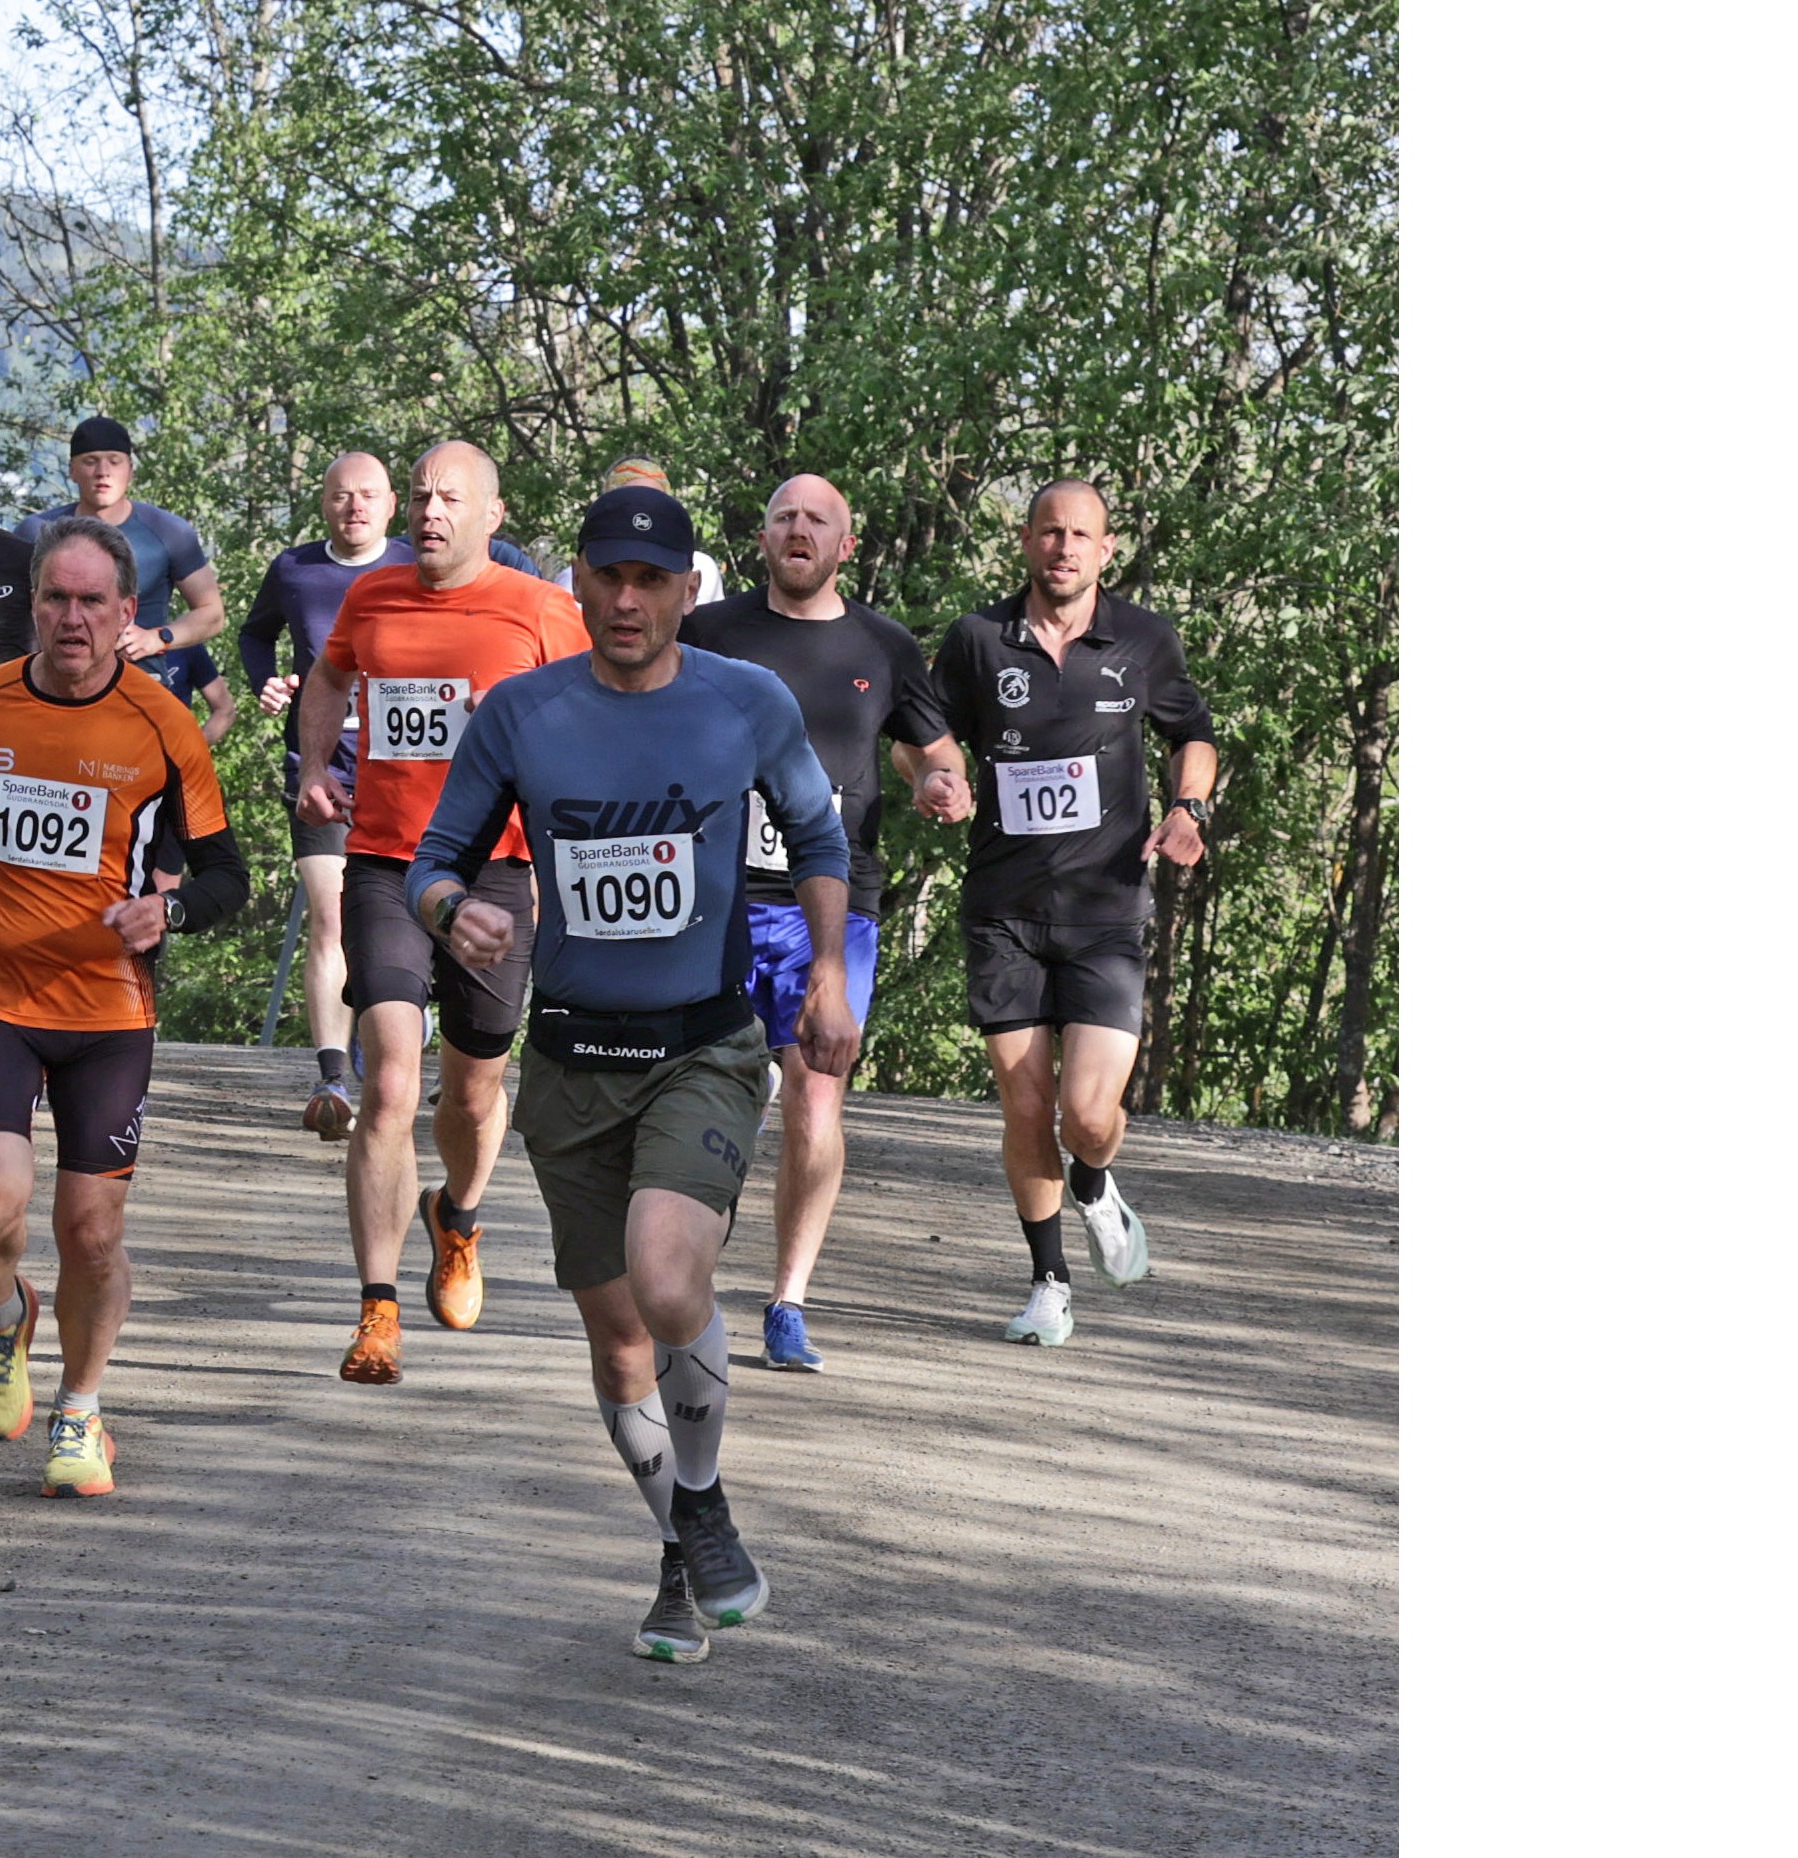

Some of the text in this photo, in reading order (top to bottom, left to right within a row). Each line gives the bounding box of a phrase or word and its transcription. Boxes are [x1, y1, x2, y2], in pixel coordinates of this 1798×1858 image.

[379, 683, 437, 695] SpareBank
[387, 707, 448, 747] 995
[1008, 764, 1065, 778] SpareBank
[2, 779, 70, 801] SpareBank
[6, 794, 69, 809] GUDBRANDSDAL
[1018, 784, 1079, 821] 102
[570, 843, 650, 862] SpareBank
[578, 859, 651, 870] GUDBRANDSDAL
[571, 871, 681, 923] 1090
[594, 927, 662, 937] Sørdalskarusellen
[573, 1043, 666, 1059] SALOMON
